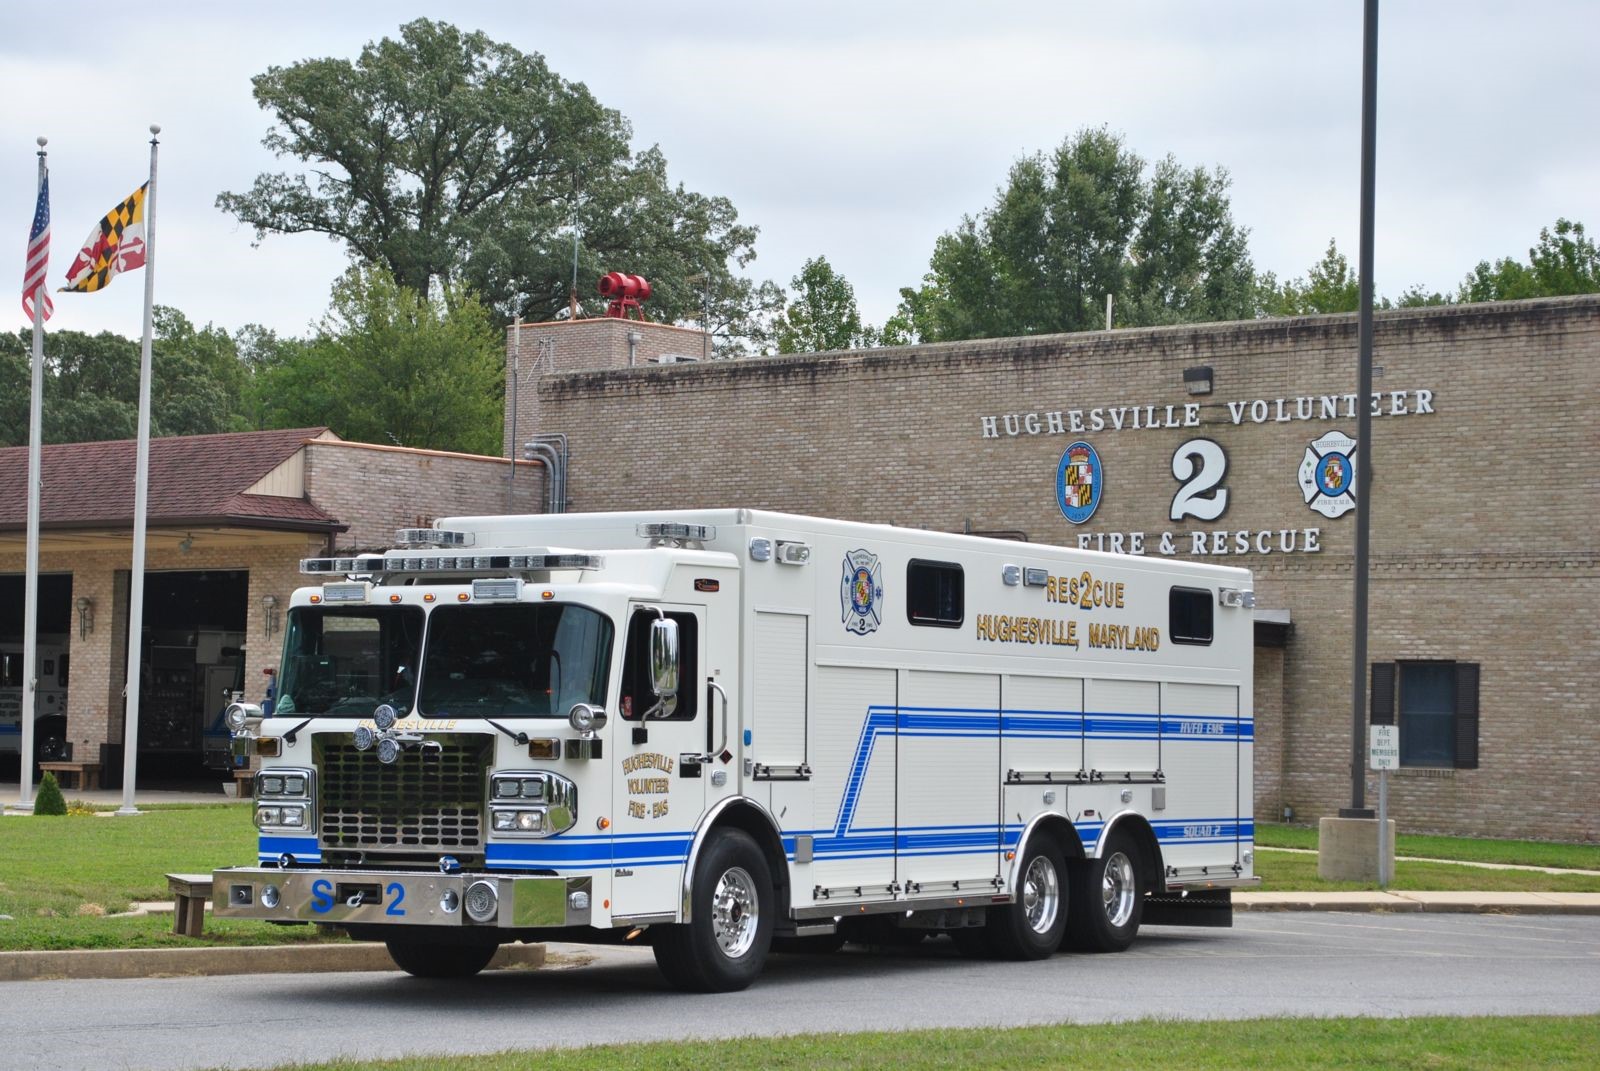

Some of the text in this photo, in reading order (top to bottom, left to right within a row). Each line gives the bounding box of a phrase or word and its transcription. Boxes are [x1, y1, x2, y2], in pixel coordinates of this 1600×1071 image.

[980, 389, 1434, 438] HUGHESVILLE VOLUNTEER
[1170, 438, 1228, 520] 2
[1077, 528, 1320, 555] FIRE & RESCUE
[859, 618, 866, 631] 2
[976, 614, 1160, 651] HUGHESVILLE, MARYLAND
[358, 719, 458, 730] HUESVILLE
[1206, 723, 1224, 735] EMS
[621, 753, 674, 775] HUGHESVILLE
[627, 778, 669, 794] VOLUNTEER
[627, 799, 669, 819] FIRE EMS
[311, 879, 405, 915] S 2
